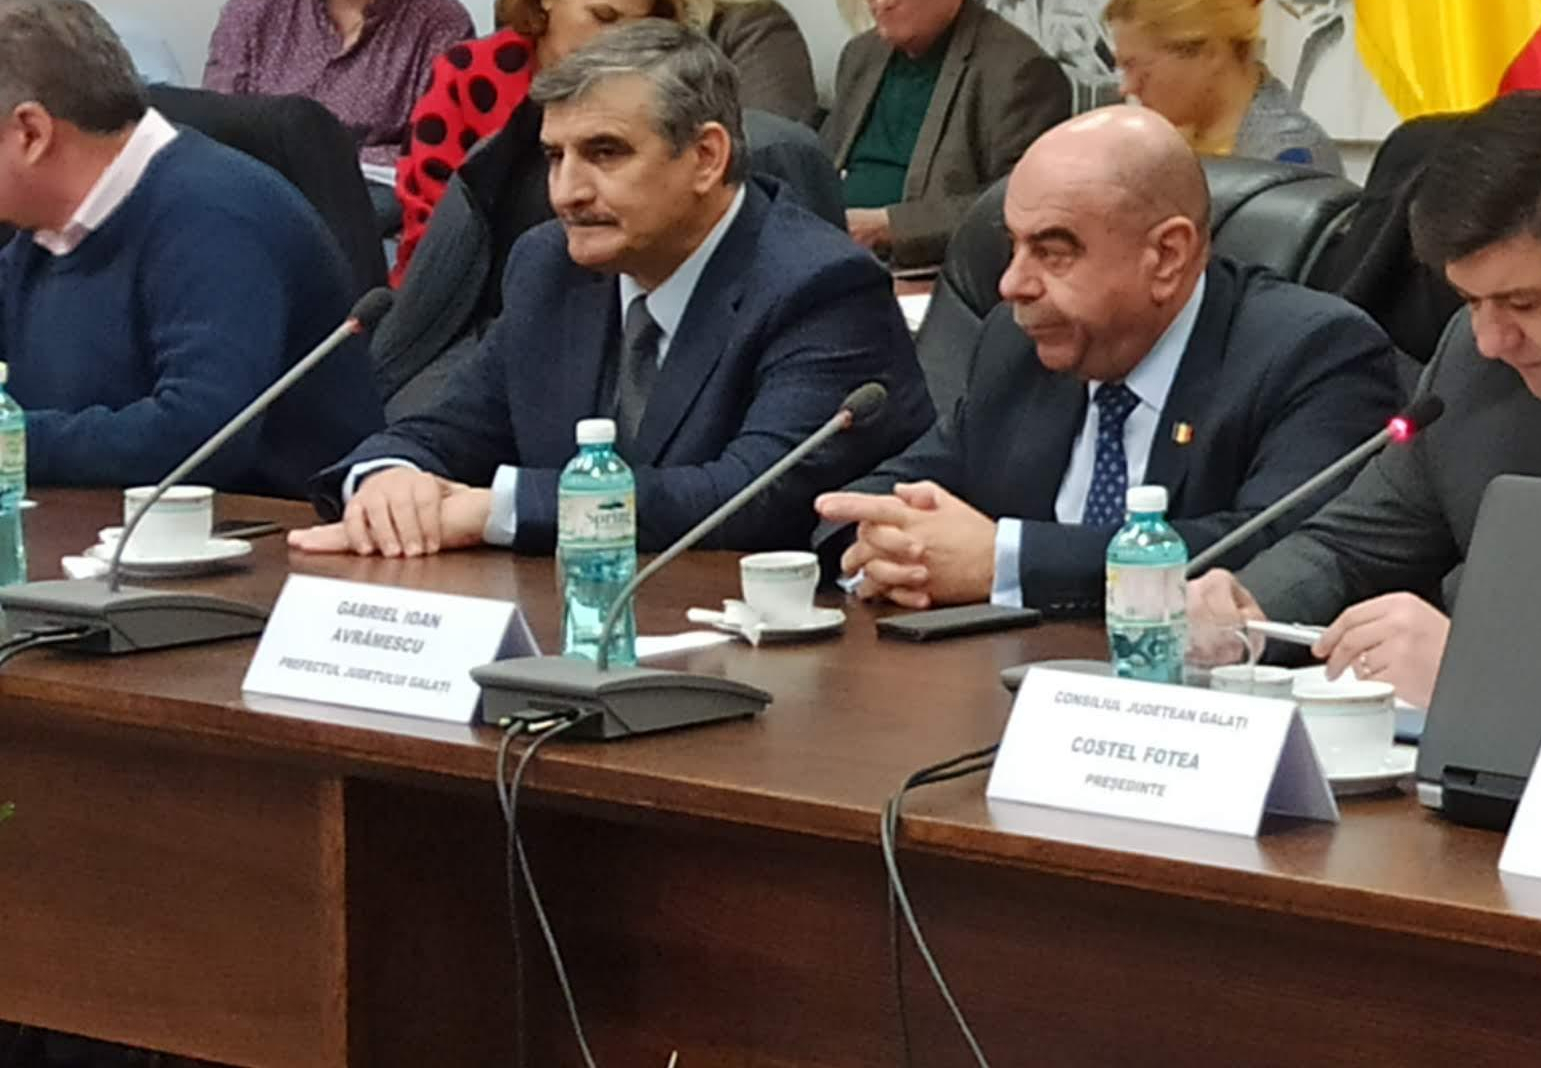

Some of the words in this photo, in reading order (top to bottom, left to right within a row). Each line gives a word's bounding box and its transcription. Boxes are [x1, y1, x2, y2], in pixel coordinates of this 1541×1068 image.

[337, 600, 398, 624] GABRIEL
[403, 610, 443, 629] IOAN
[278, 656, 341, 677] PREFECTUL
[1053, 690, 1121, 712] CONSILIUL
[1071, 735, 1137, 762] COSTEL
[1142, 746, 1200, 770] FOTEA
